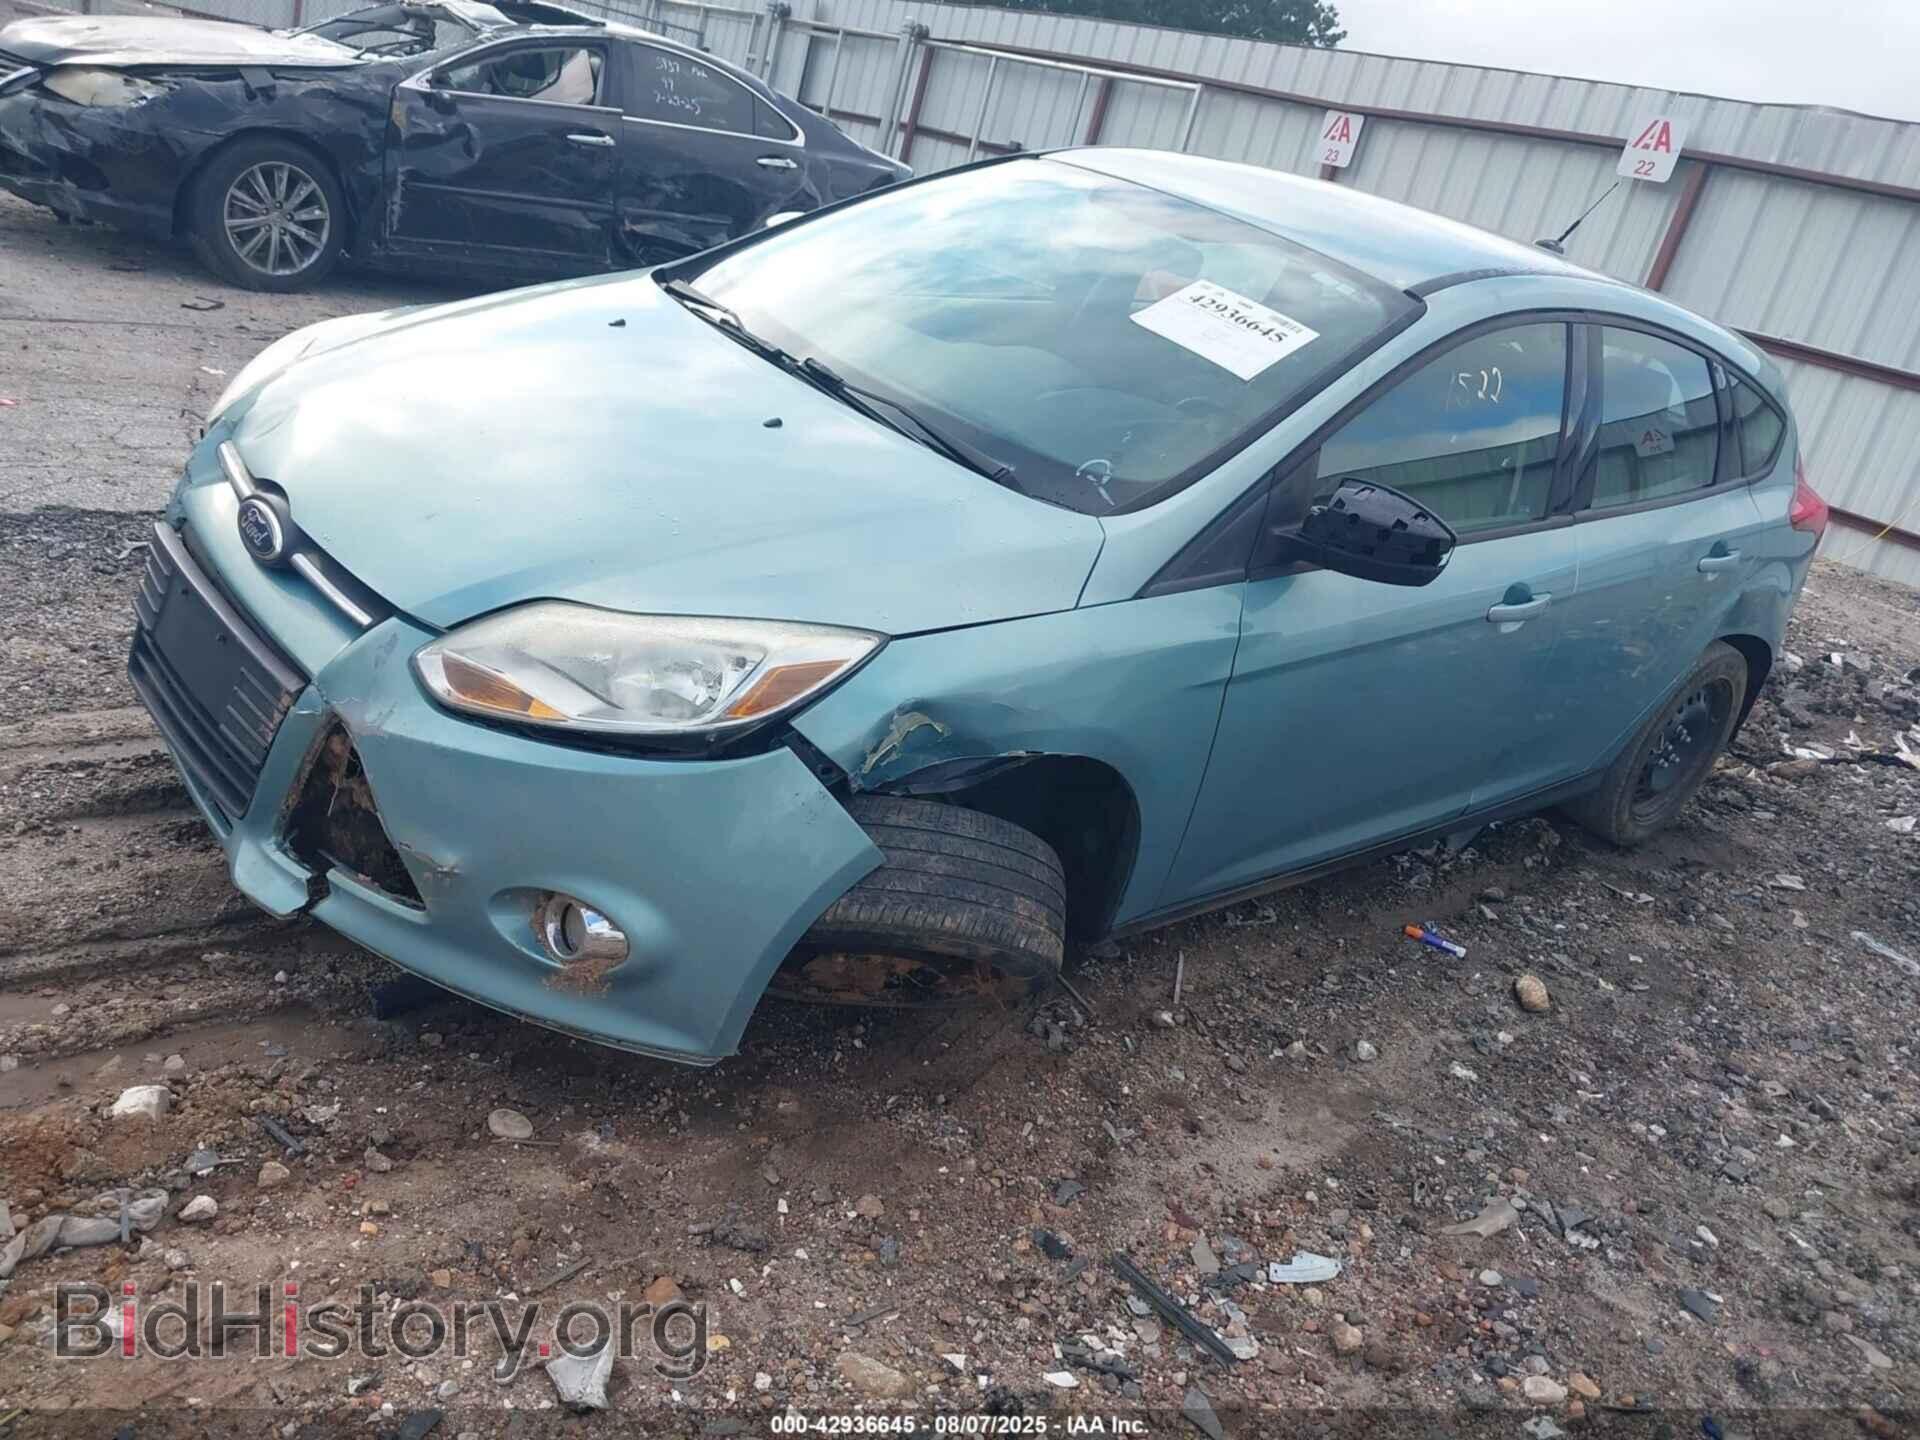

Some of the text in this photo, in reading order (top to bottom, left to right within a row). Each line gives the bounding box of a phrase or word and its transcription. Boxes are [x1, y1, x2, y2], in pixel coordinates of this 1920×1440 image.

[1324, 148, 1340, 162] 23
[1633, 159, 1656, 176] 22
[1189, 294, 1289, 344] 42936645
[240, 507, 268, 547] Ford
